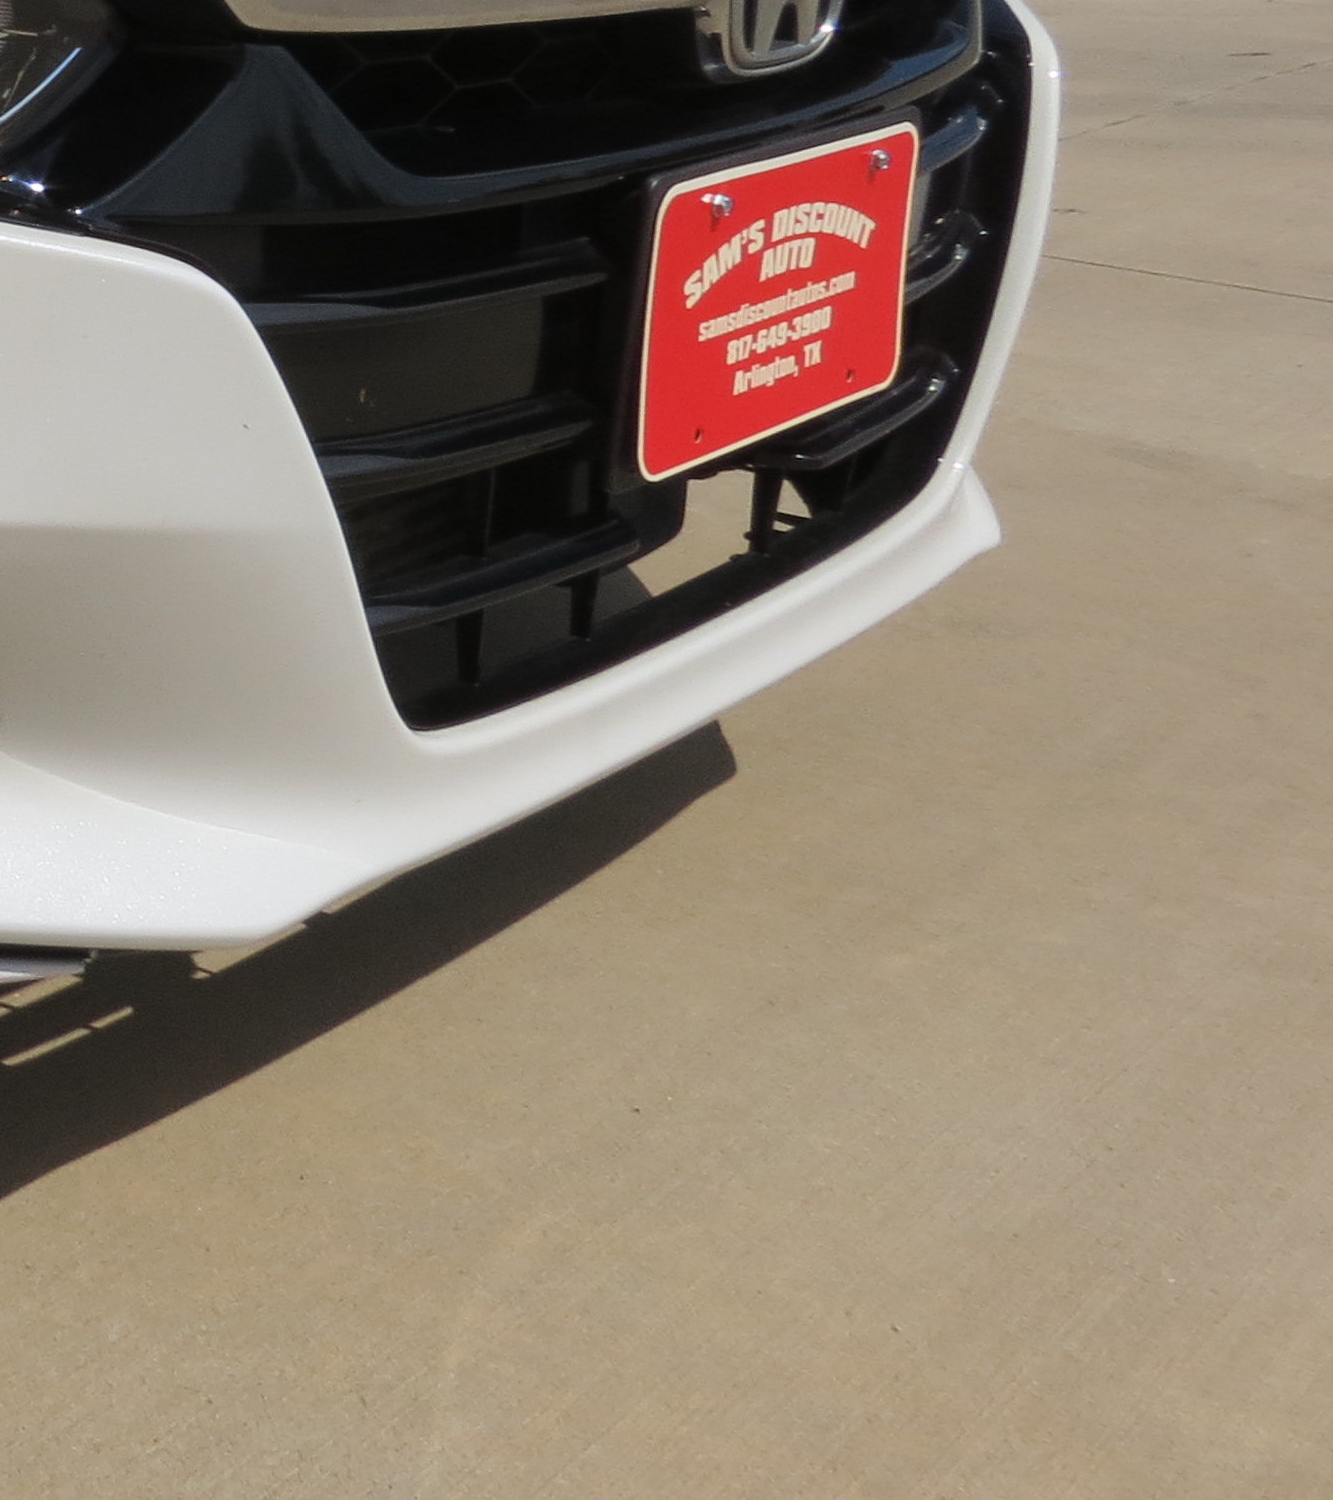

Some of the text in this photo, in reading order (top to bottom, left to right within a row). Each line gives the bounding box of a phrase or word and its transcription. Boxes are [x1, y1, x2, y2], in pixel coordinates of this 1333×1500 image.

[683, 202, 877, 310] SAM'S DISCOUNT
[759, 236, 817, 282] AUTO
[733, 340, 822, 395] Arlington, TX
